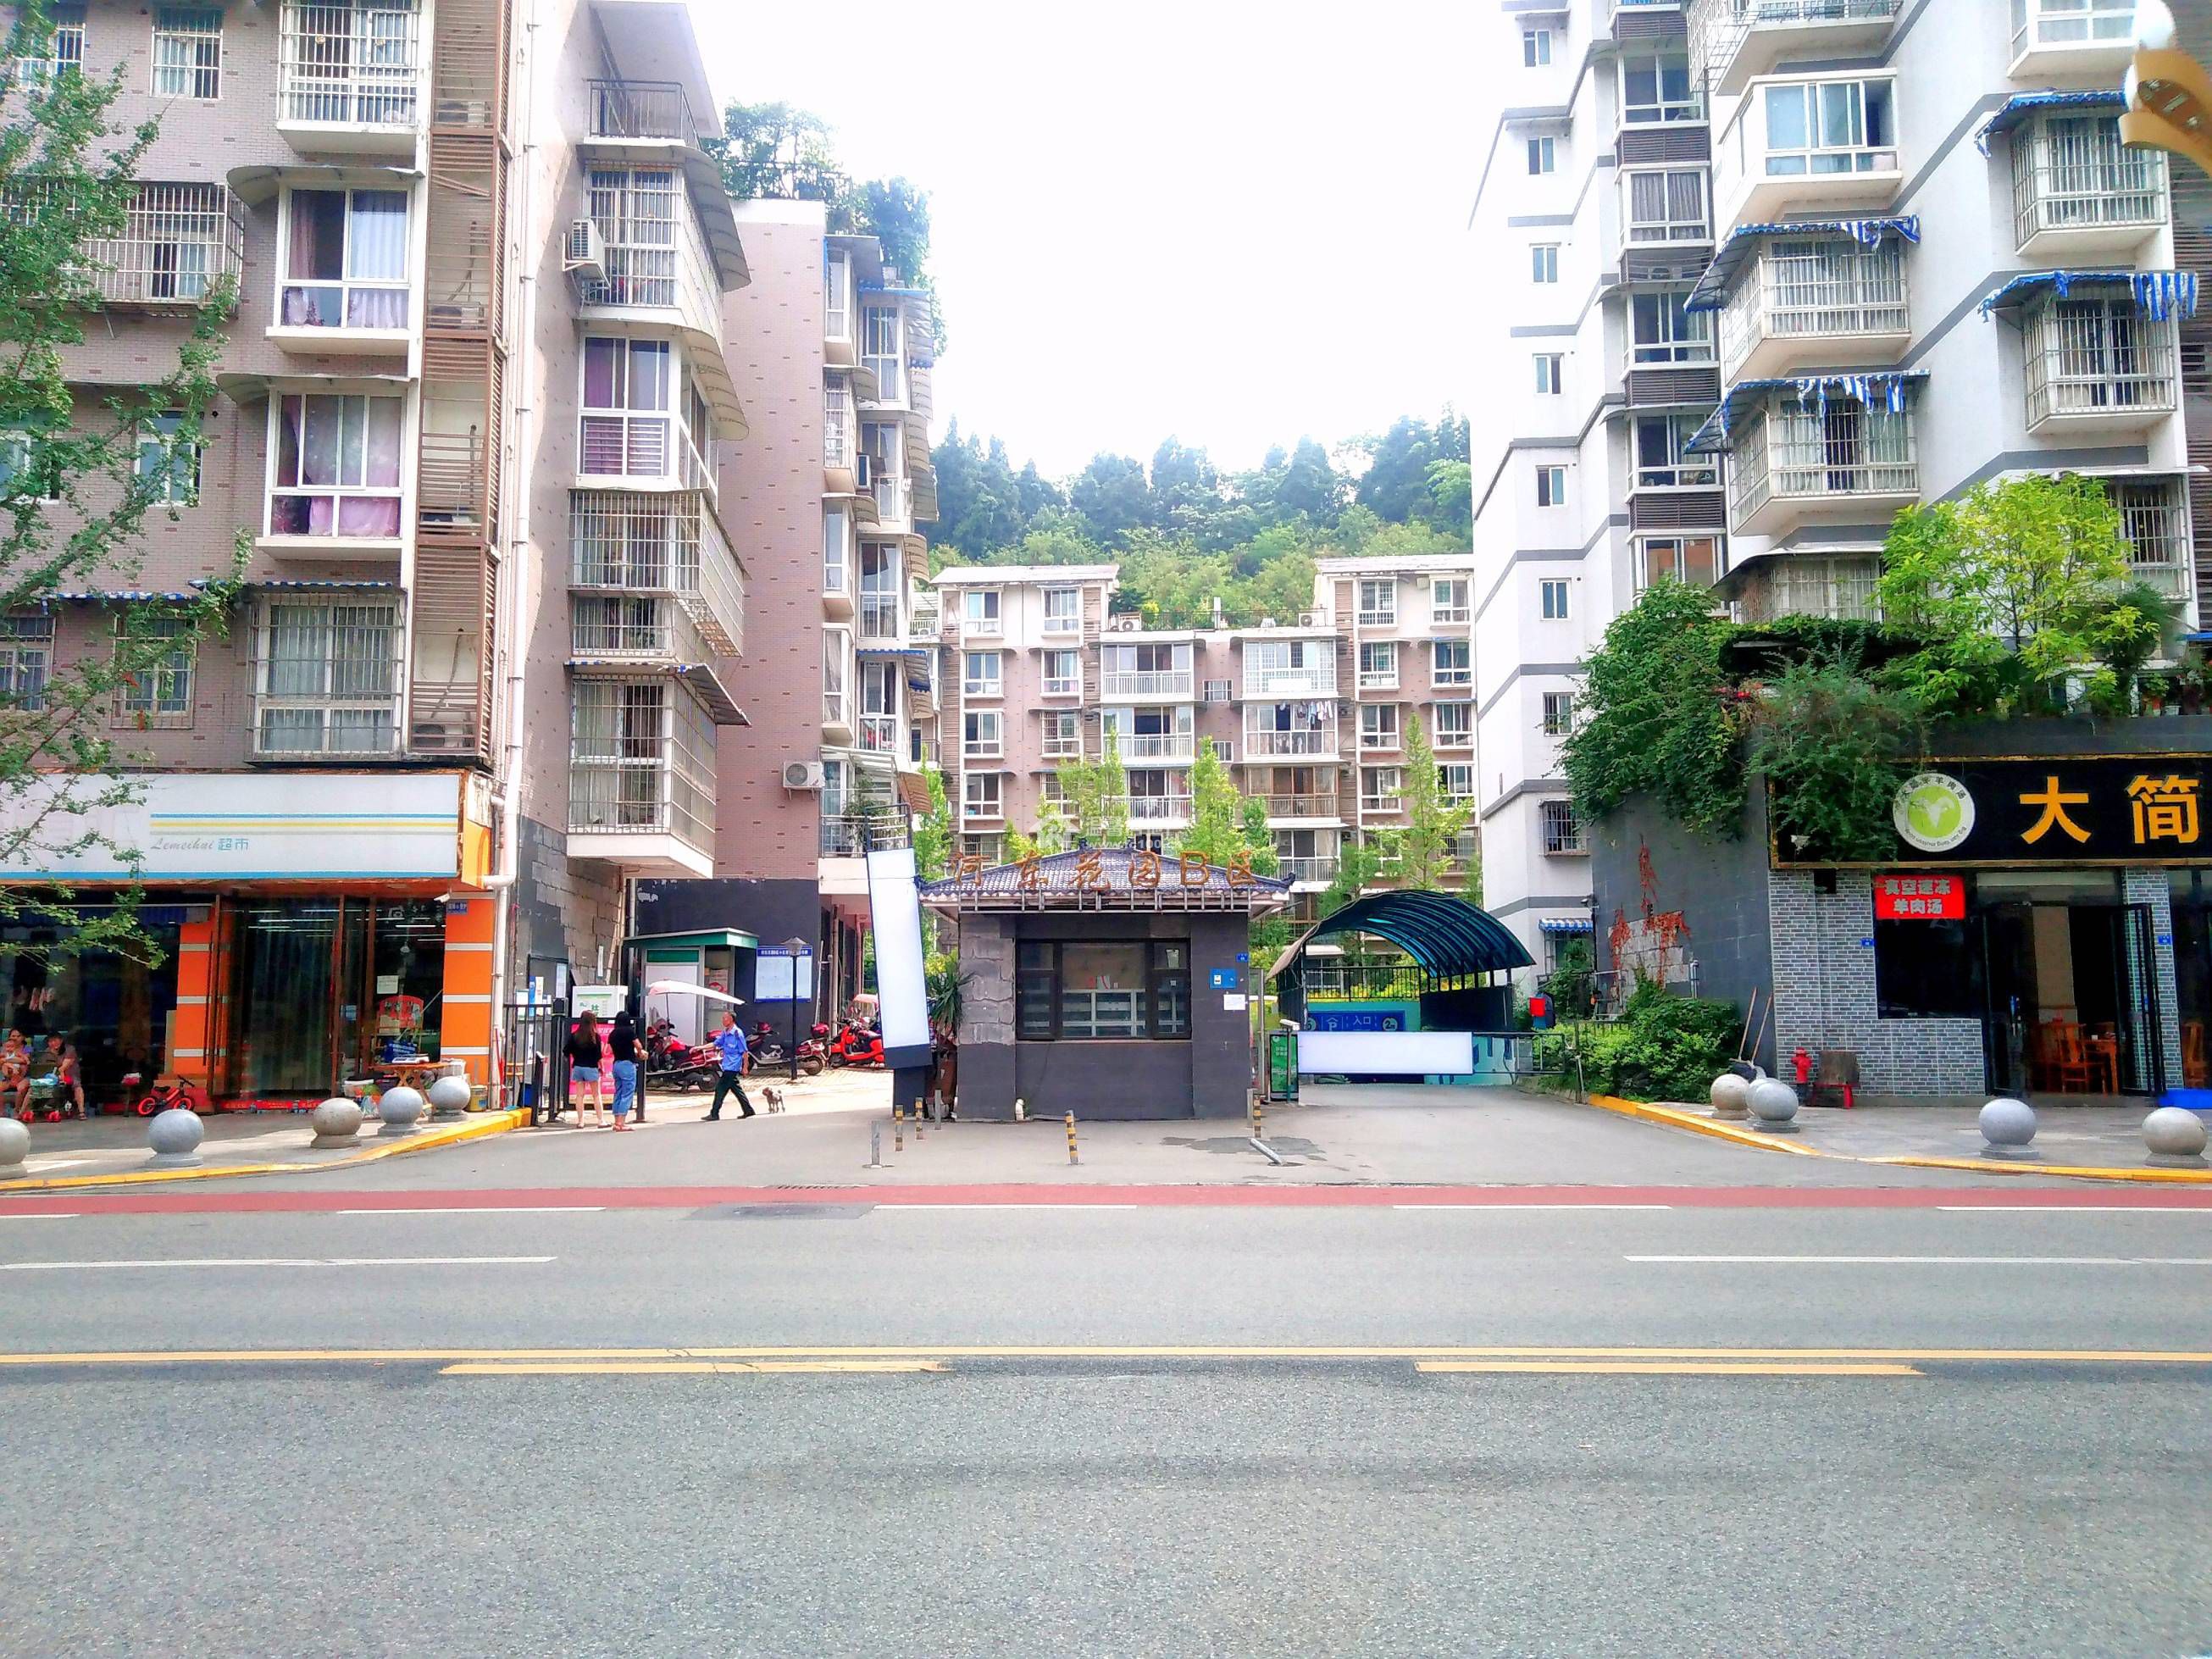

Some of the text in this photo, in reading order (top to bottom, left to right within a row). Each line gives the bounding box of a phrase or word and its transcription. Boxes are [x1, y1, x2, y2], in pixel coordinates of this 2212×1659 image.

[2019, 774, 2199, 845] 大简
[218, 838, 249, 851] 超市
[949, 846, 1258, 891] 河东花园B区
[1893, 898, 1943, 914] 羊肉汤
[1353, 1016, 1371, 1025] 入口
